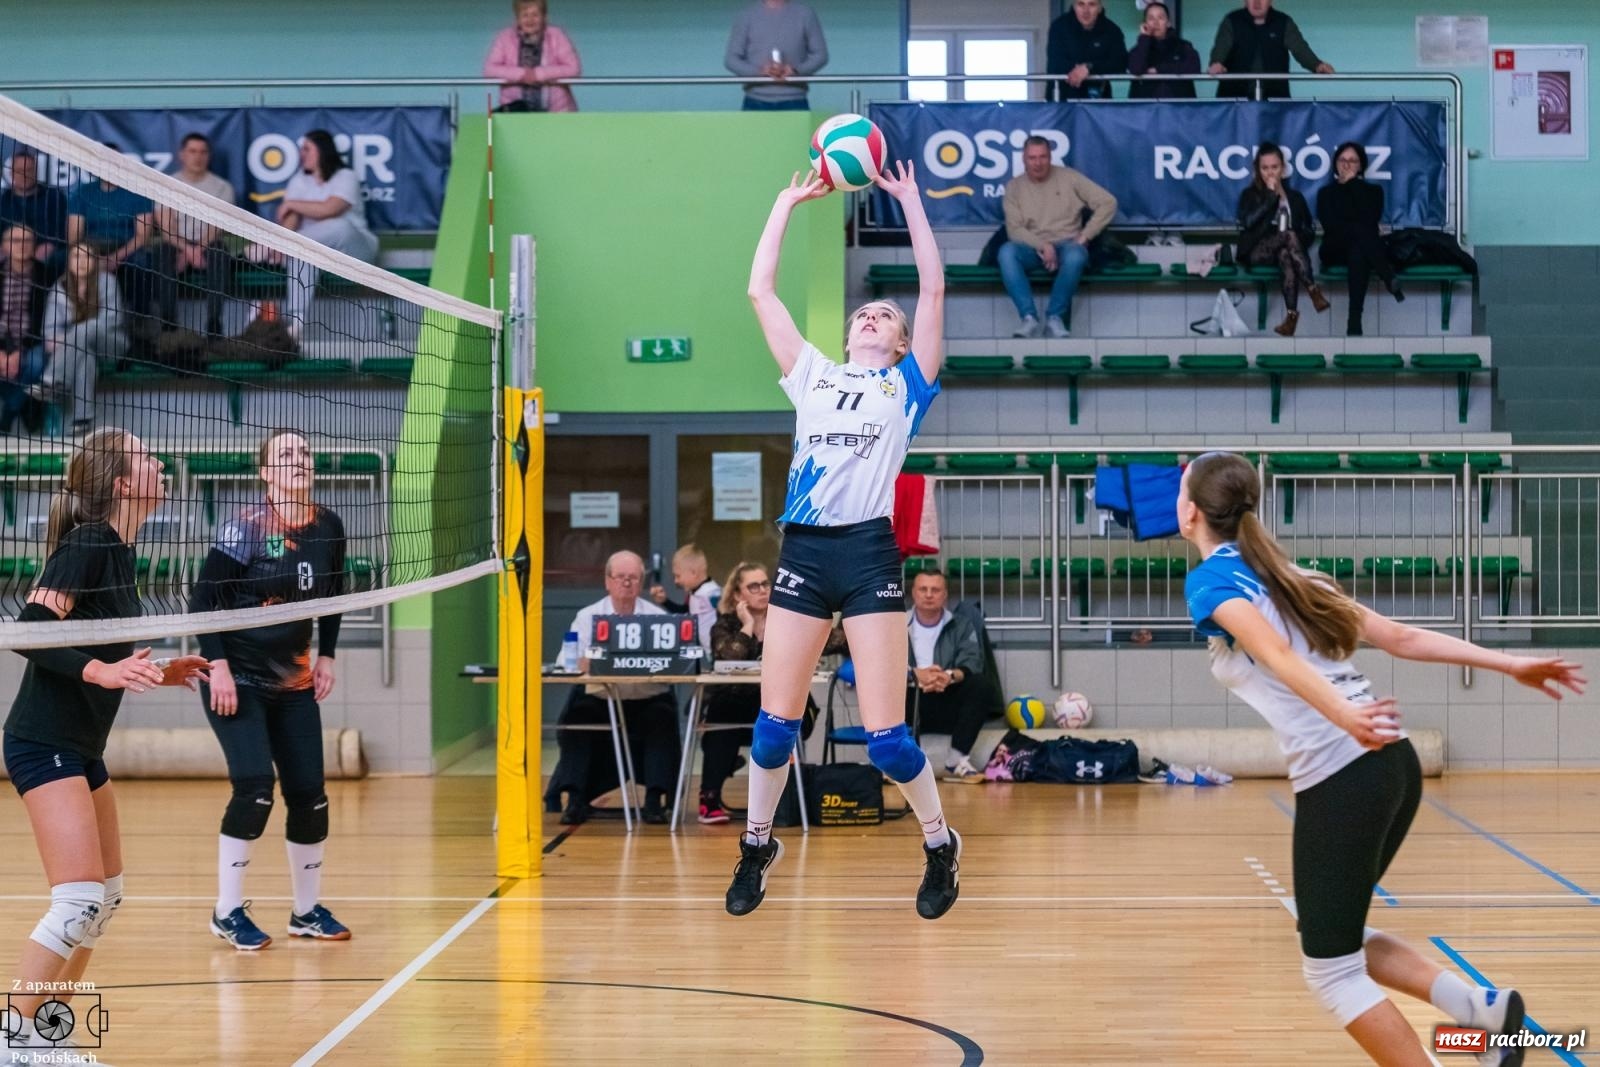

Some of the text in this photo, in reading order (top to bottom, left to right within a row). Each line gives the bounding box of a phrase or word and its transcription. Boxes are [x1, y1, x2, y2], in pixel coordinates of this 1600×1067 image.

[836, 389, 865, 411] 77
[615, 622, 642, 650] 18
[650, 622, 677, 650] 19
[613, 657, 673, 671] MODEST
[822, 794, 841, 808] 3D
